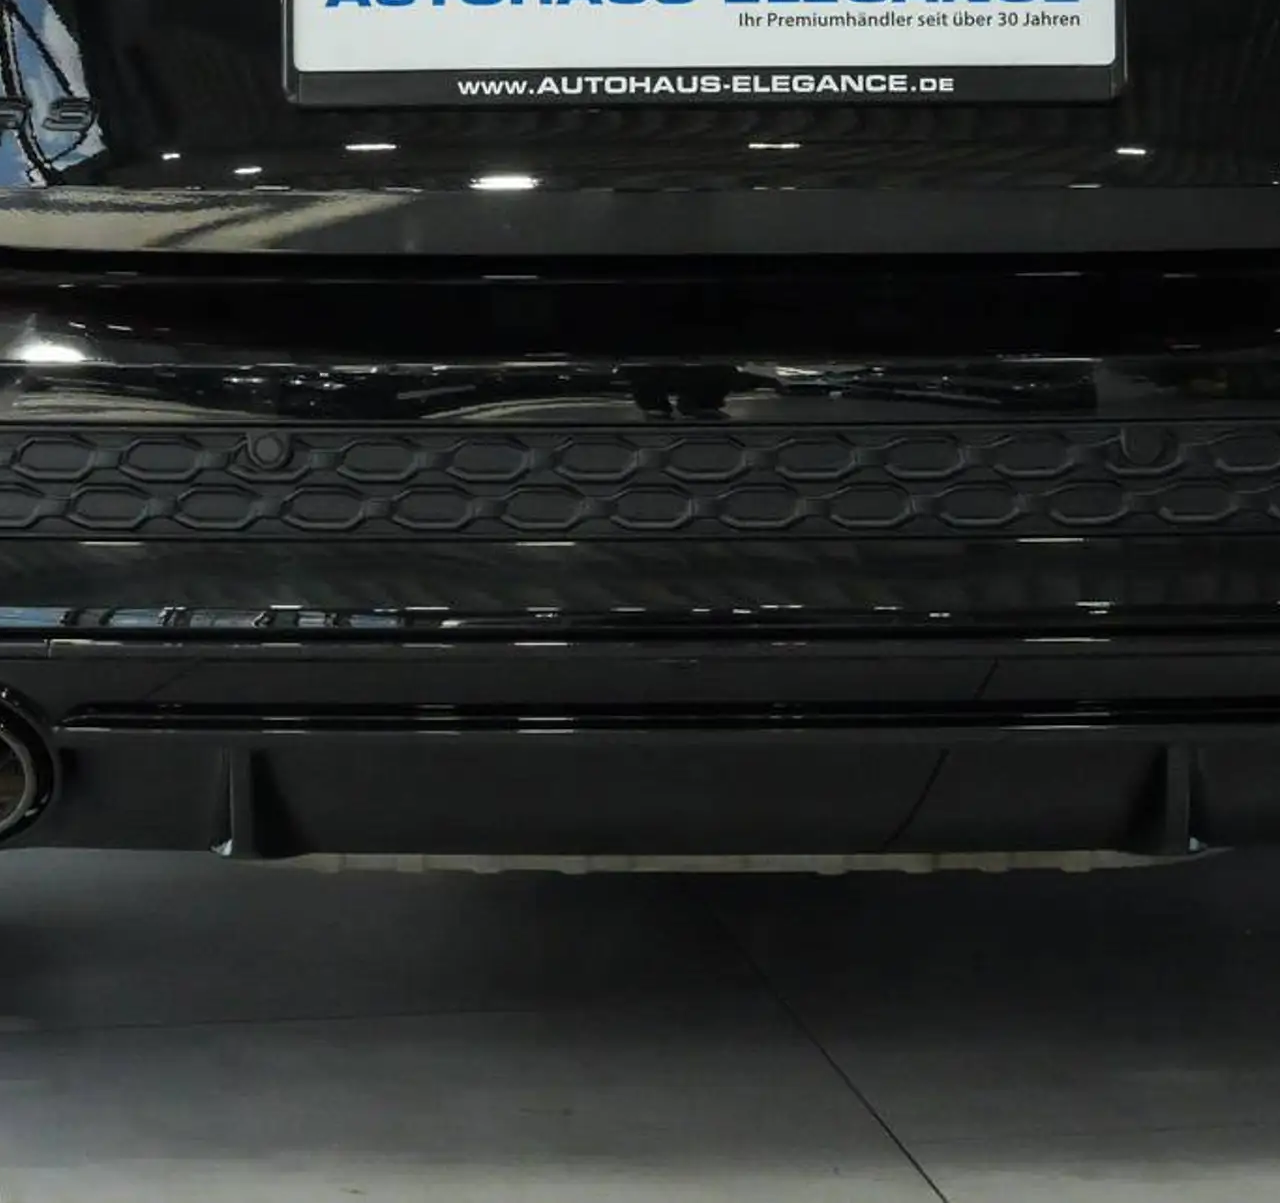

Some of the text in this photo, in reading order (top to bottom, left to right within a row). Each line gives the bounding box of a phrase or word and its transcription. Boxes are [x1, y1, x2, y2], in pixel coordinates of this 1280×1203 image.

[739, 10, 1081, 28] Ihr Premiumhändler seit über 30 Jahren
